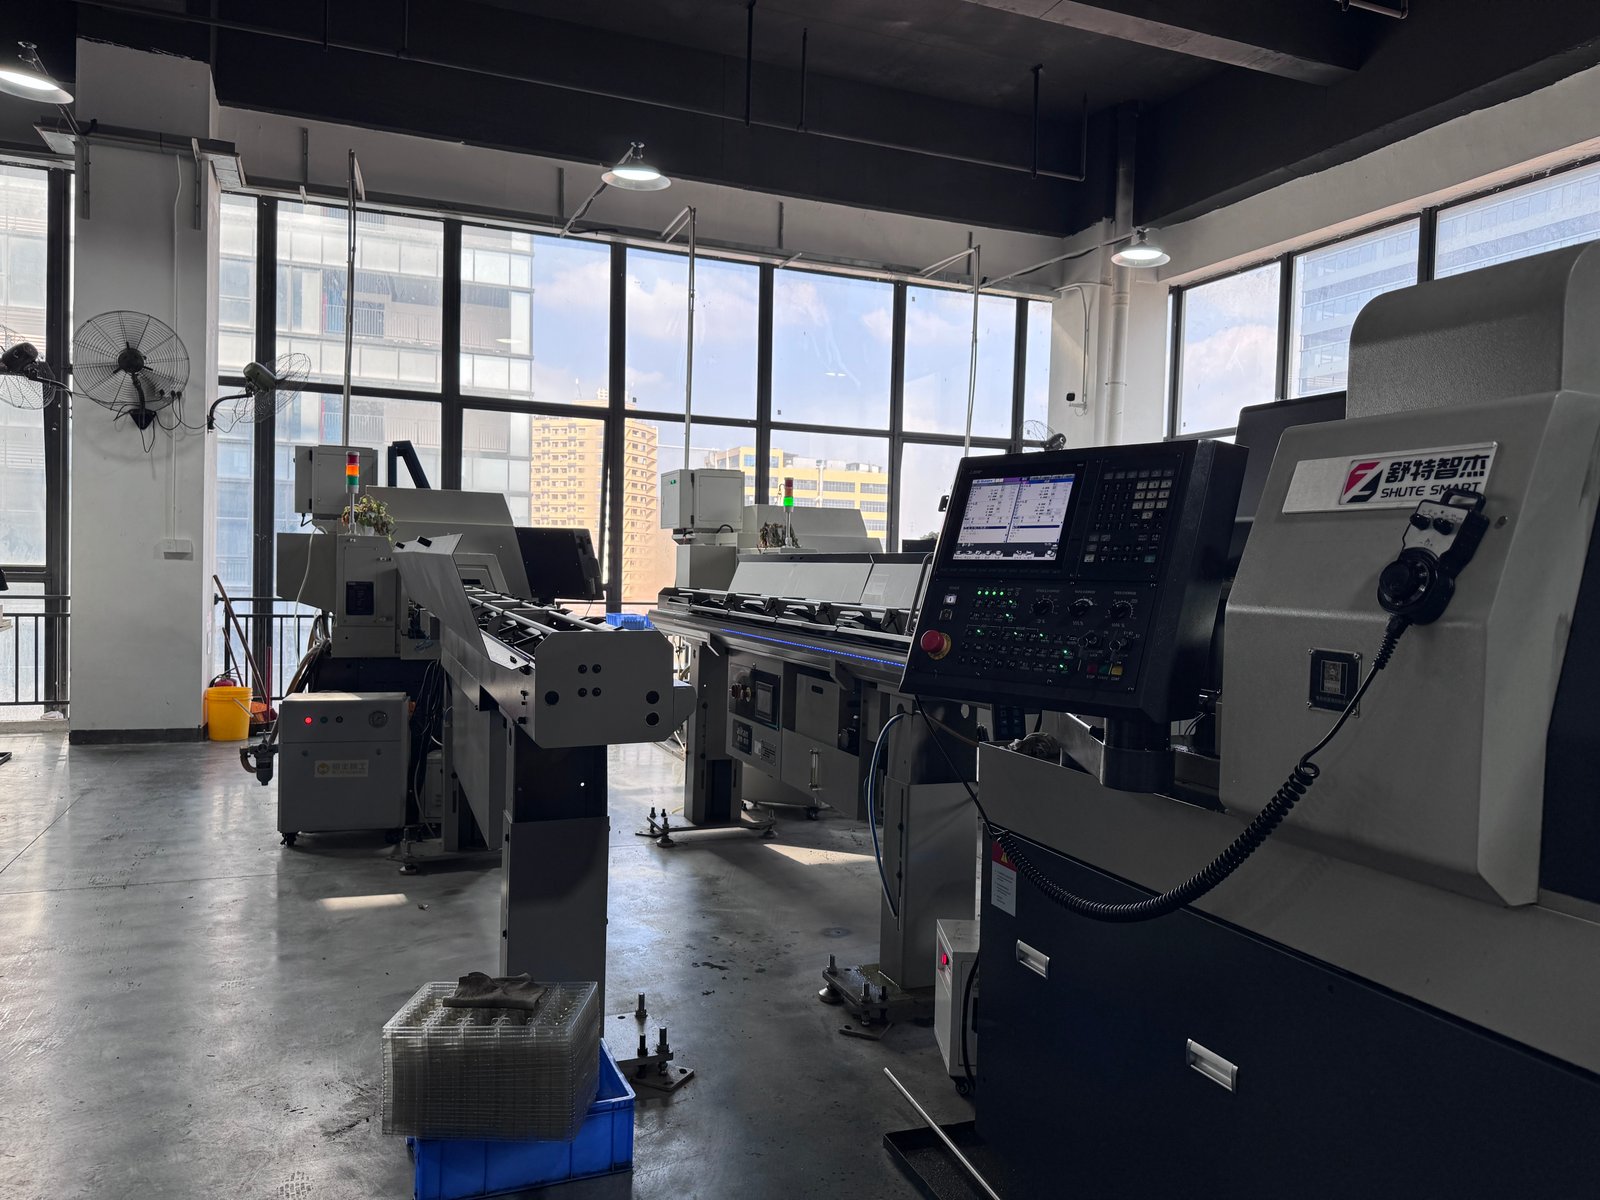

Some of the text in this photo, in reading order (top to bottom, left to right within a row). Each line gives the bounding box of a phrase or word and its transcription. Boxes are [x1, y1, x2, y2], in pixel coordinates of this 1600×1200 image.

[1385, 455, 1490, 483] 舒特智杰
[1380, 486, 1426, 498] SHUTE
